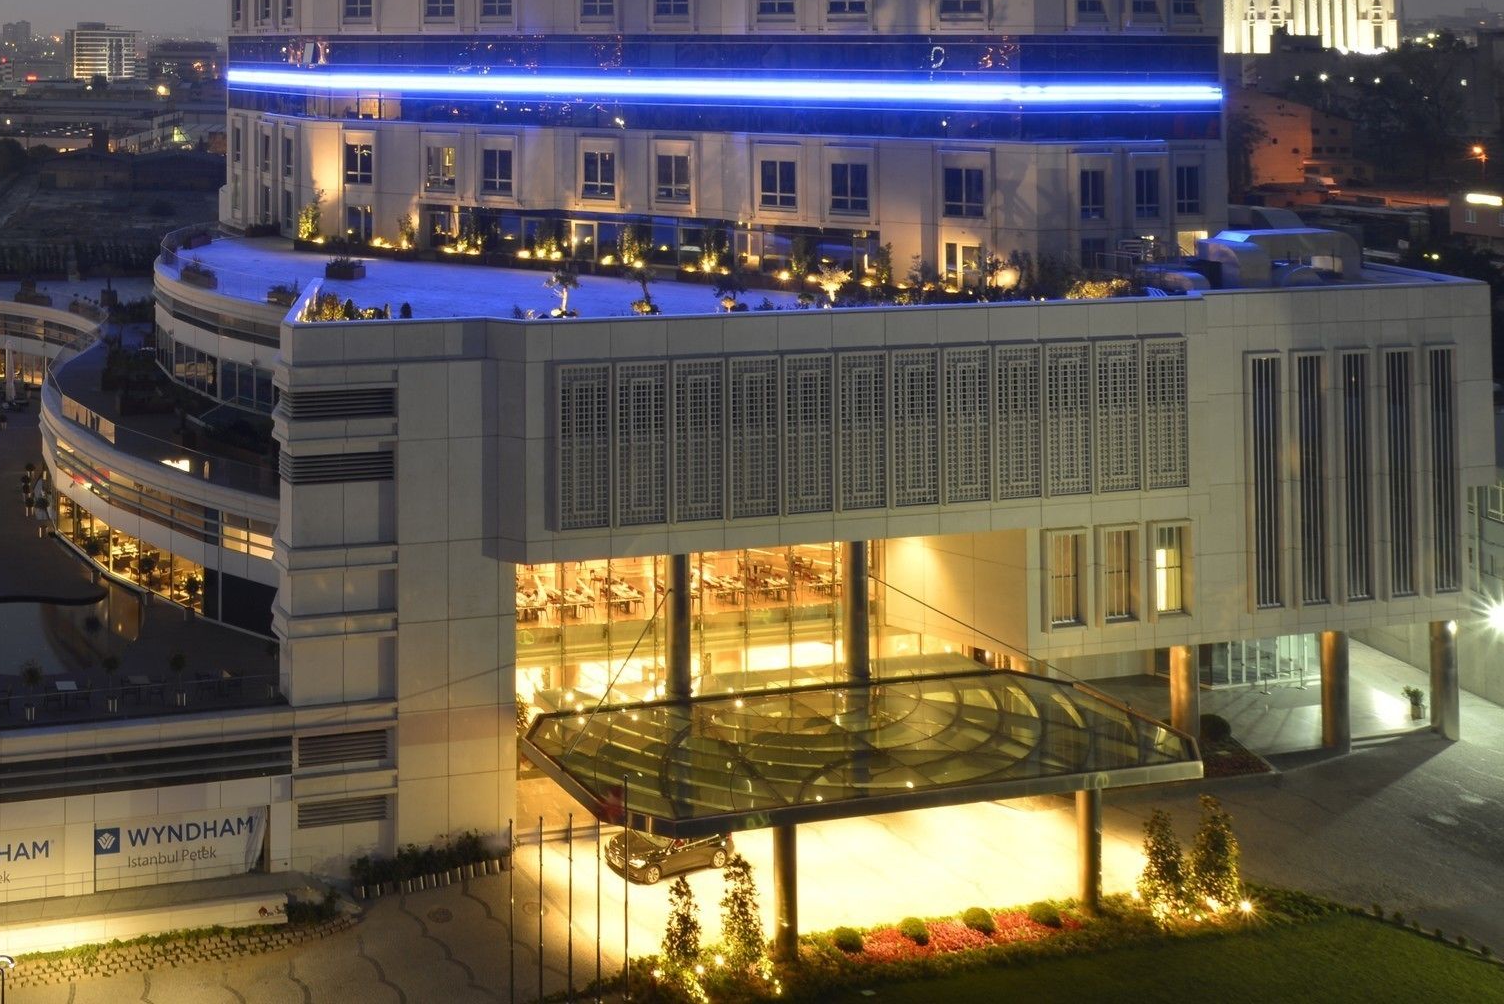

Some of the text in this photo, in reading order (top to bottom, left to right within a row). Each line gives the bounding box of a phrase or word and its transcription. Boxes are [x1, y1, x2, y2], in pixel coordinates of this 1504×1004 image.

[128, 815, 254, 847] WYNDHAM
[127, 845, 217, 868] Istanbul Petek
